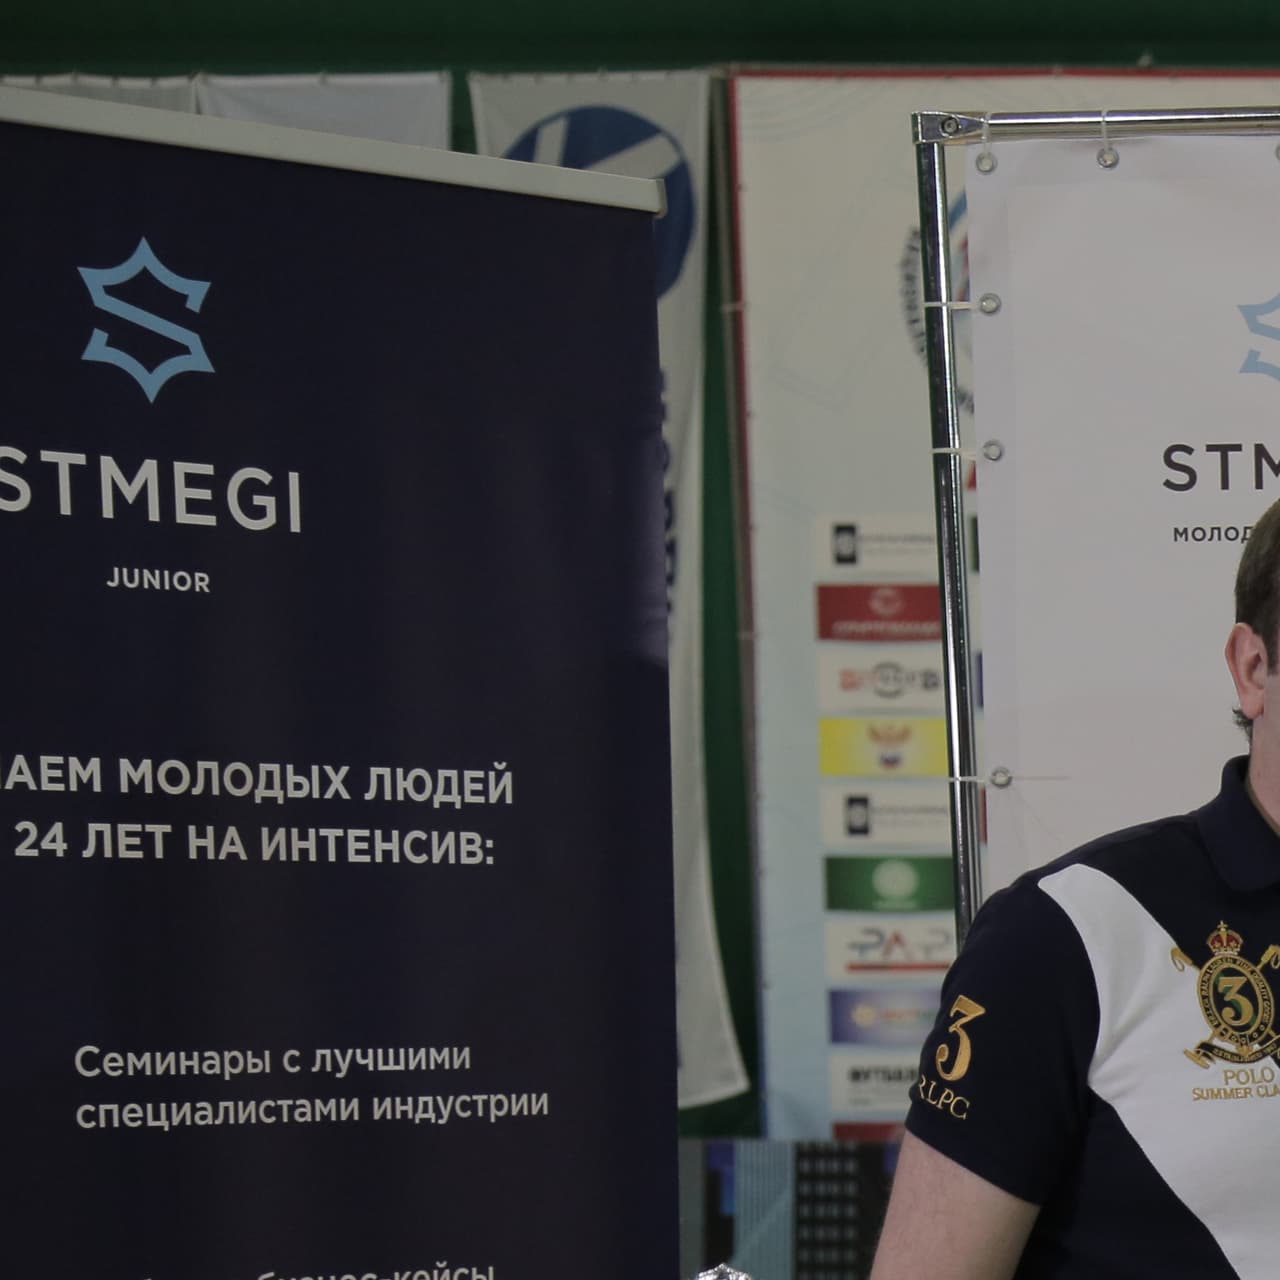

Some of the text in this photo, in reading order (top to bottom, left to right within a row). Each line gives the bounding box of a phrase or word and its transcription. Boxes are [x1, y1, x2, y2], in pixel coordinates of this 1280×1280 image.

[106, 567, 211, 593] JUNIOR
[0, 754, 514, 808] АЕМ МОЛОДЫХ ЛЮДЕЙ
[14, 821, 496, 865] 24 ЛЕТ НА ИНТЕНСИВ:
[1219, 978, 1254, 1026] 3
[936, 994, 986, 1082] 3
[74, 1045, 472, 1079] Семинары с лучшими
[1223, 1066, 1275, 1086] POLO
[75, 1091, 550, 1132] специалистами индустрии
[1192, 1086, 1254, 1102] SUMMER
